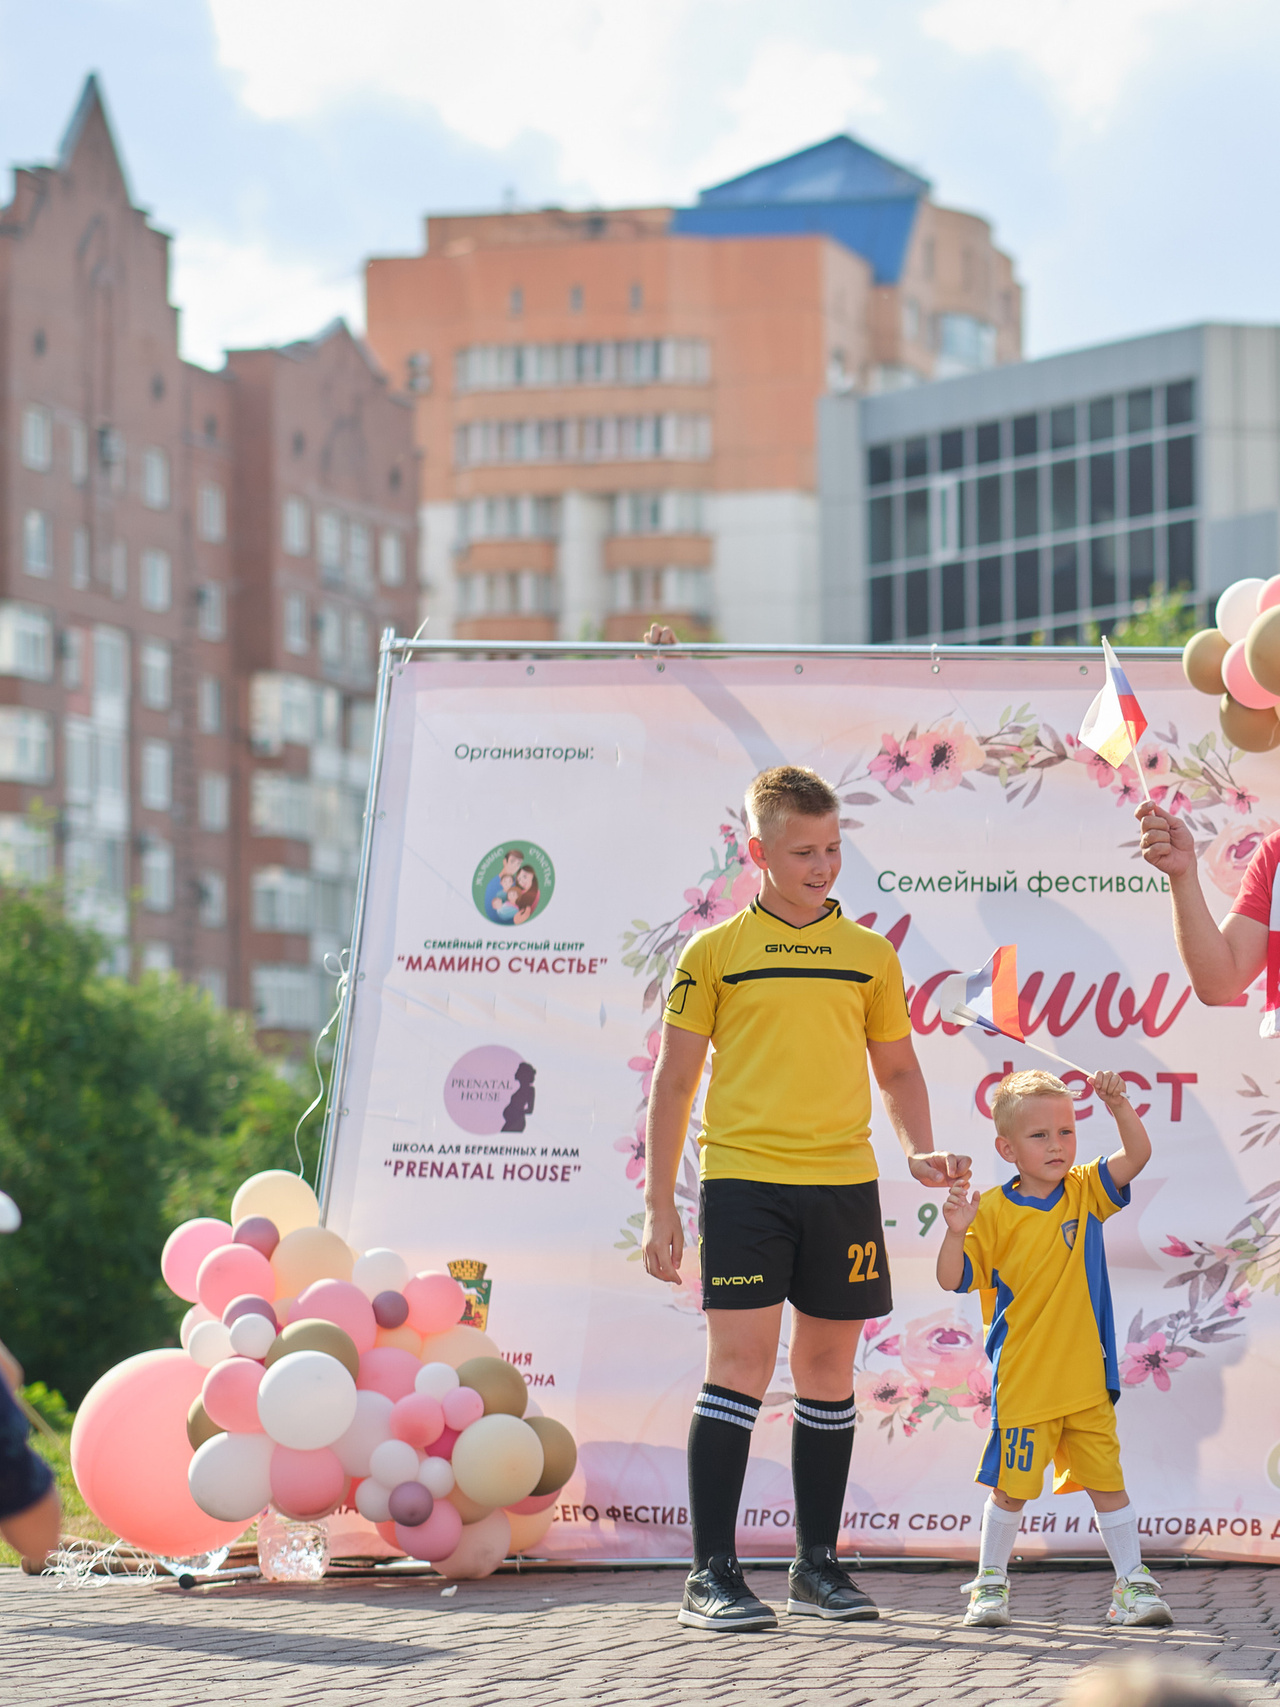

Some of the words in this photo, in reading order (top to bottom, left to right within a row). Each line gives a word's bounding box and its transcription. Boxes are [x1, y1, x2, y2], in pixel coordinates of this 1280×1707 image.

[454, 743, 594, 762] Организаторы:
[877, 870, 1018, 893] Семейный
[1027, 870, 1171, 898] фестиваль
[424, 939, 483, 950] СЕМЕЙНЫЙ
[486, 940, 550, 951] РЕСУРСНЫЙ
[553, 941, 585, 951] ЦЕНТР
[765, 944, 832, 955] GIVOVA
[451, 1078, 513, 1090] PRENATAL
[461, 1091, 500, 1102] HOUSE
[392, 1143, 434, 1153] ШКОЛА
[438, 1144, 461, 1154] ДЛЯ
[464, 1145, 537, 1156] БЕРЕМЕННЫХ
[540, 1147, 548, 1157] И
[551, 1148, 580, 1158] МАМ
[917, 1203, 939, 1238] 9
[848, 1241, 880, 1283] 22
[711, 1274, 764, 1286] GIVOVA
[1005, 1427, 1035, 1472] 35
[606, 1504, 692, 1525] ФЕСТИВ
[908, 1513, 971, 1532] СБОР
[1065, 1517, 1079, 1533] И
